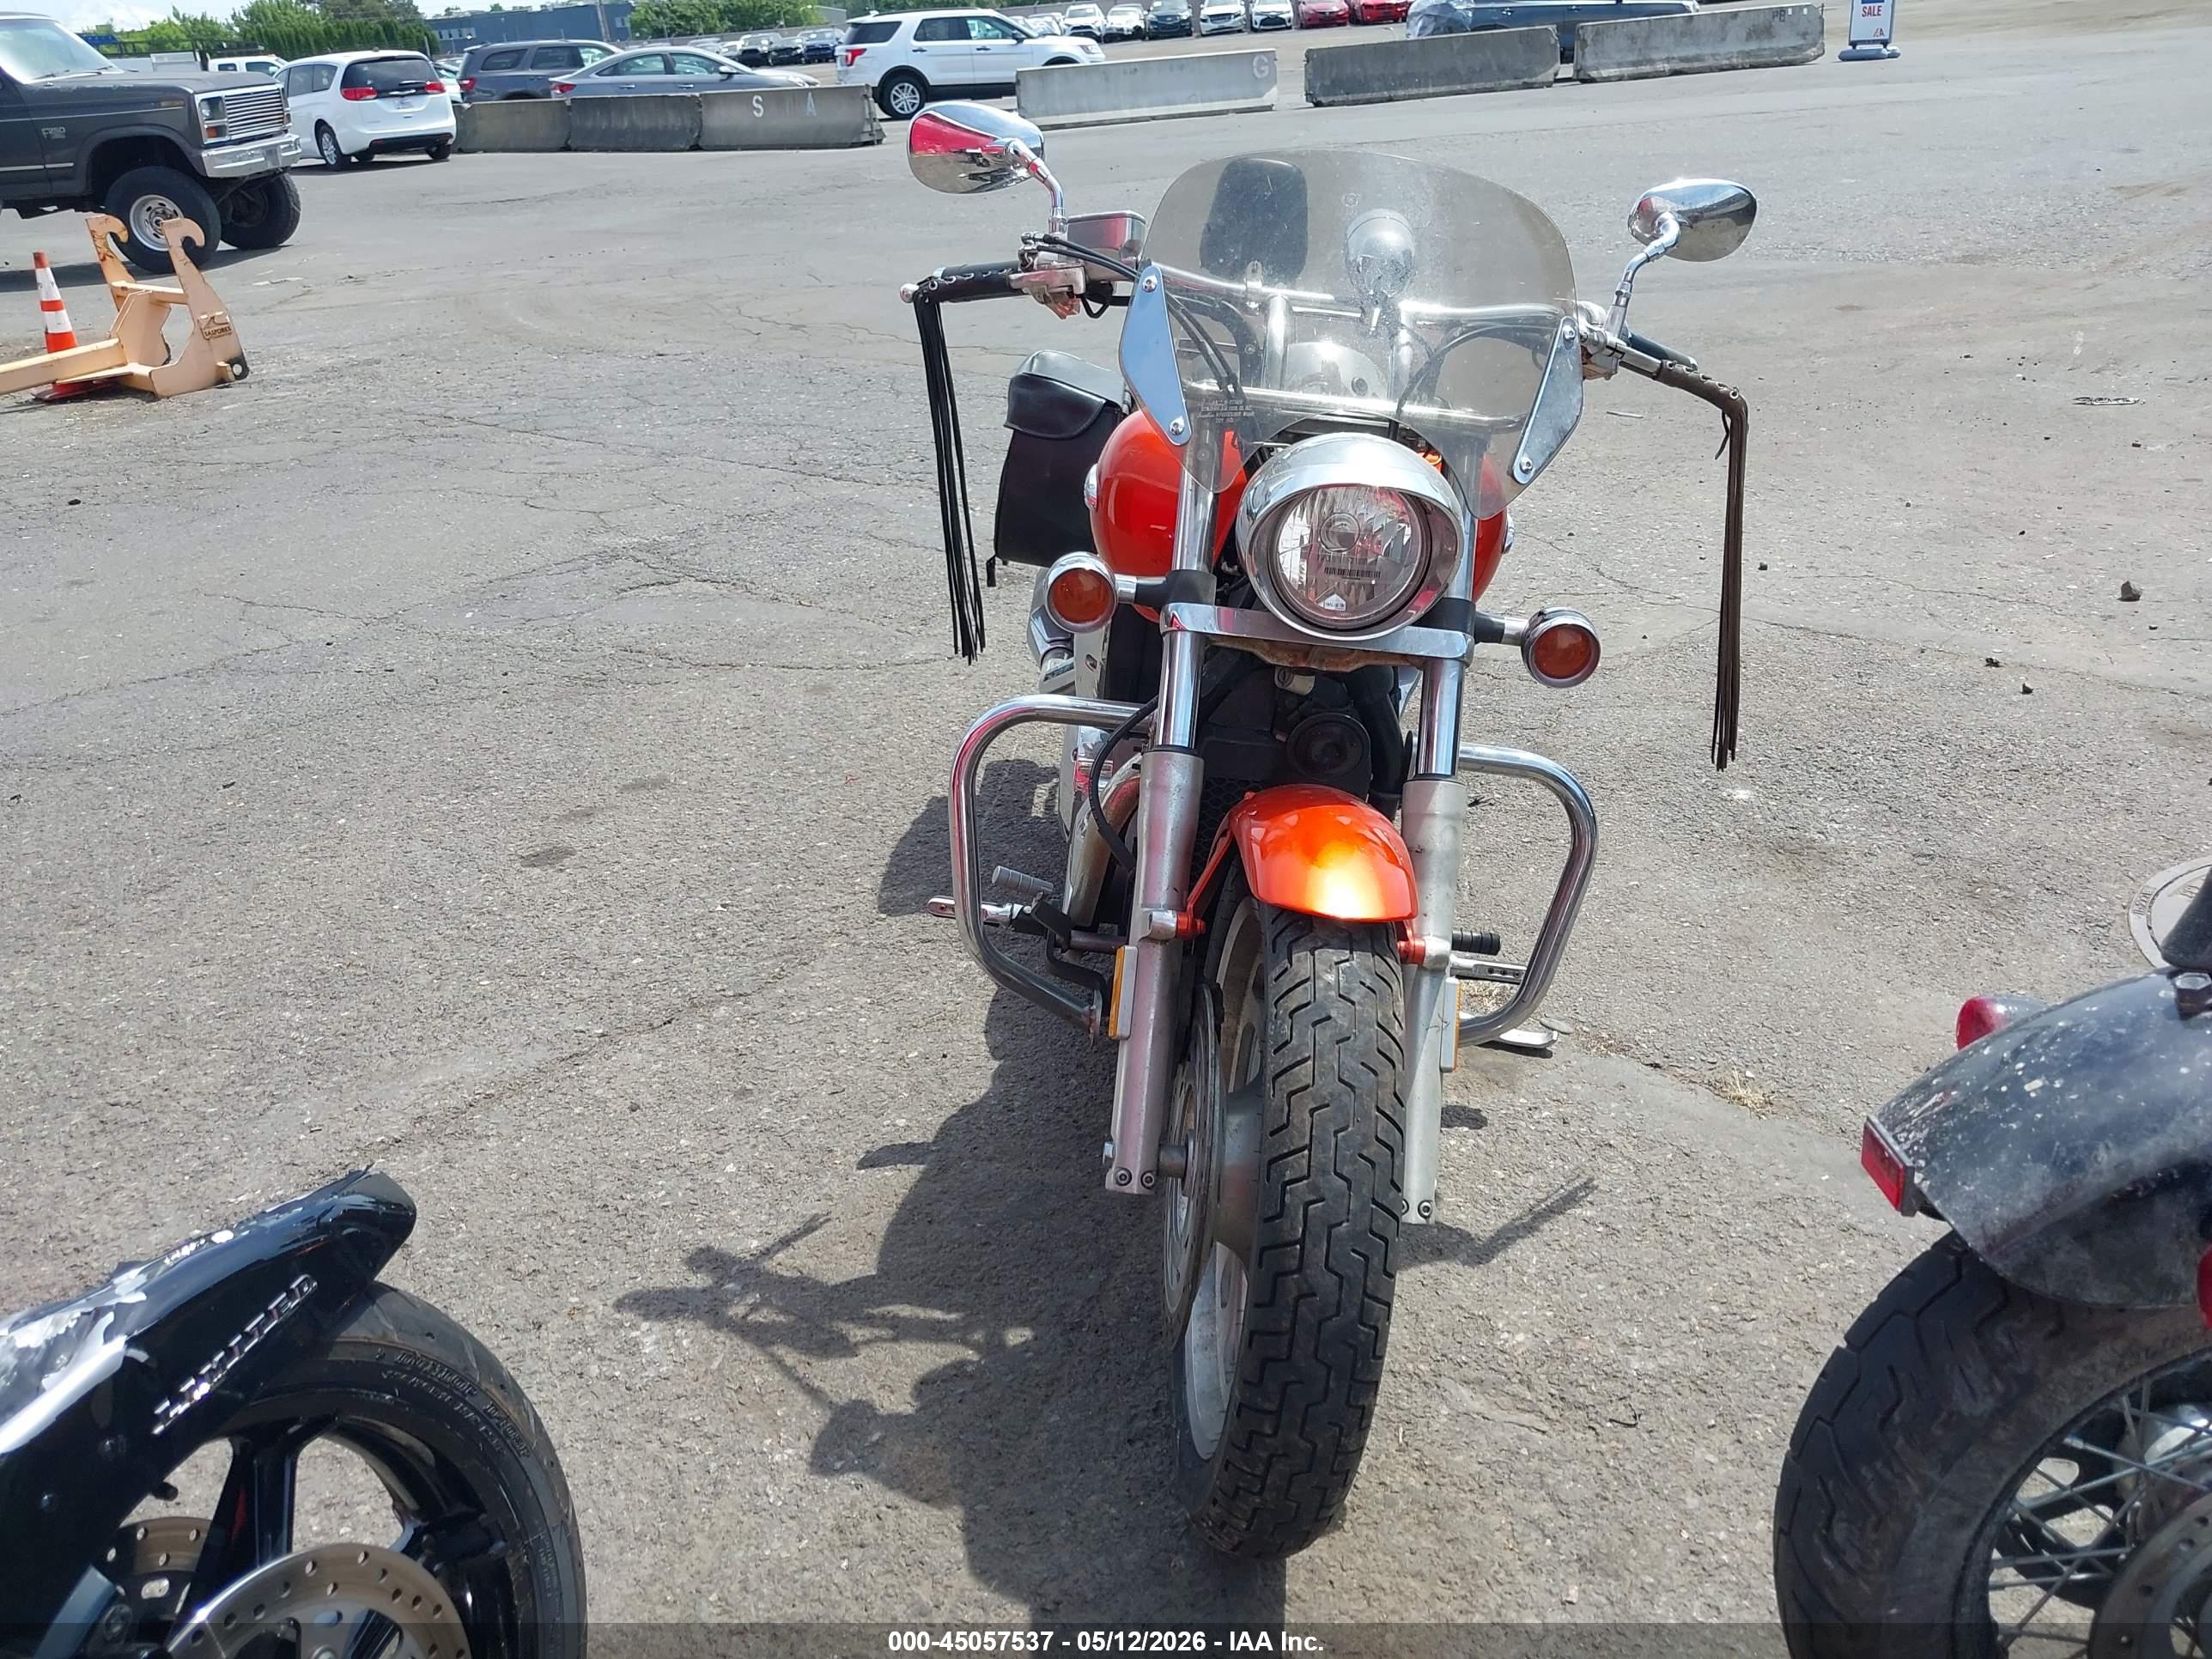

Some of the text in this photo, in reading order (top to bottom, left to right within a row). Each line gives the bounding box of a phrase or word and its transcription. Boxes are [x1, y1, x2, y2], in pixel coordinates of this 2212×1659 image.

[1862, 5, 1882, 17] SALE
[1253, 54, 1269, 78] G
[752, 91, 817, 118] S A
[151, 1273, 319, 1436] LIMITED
